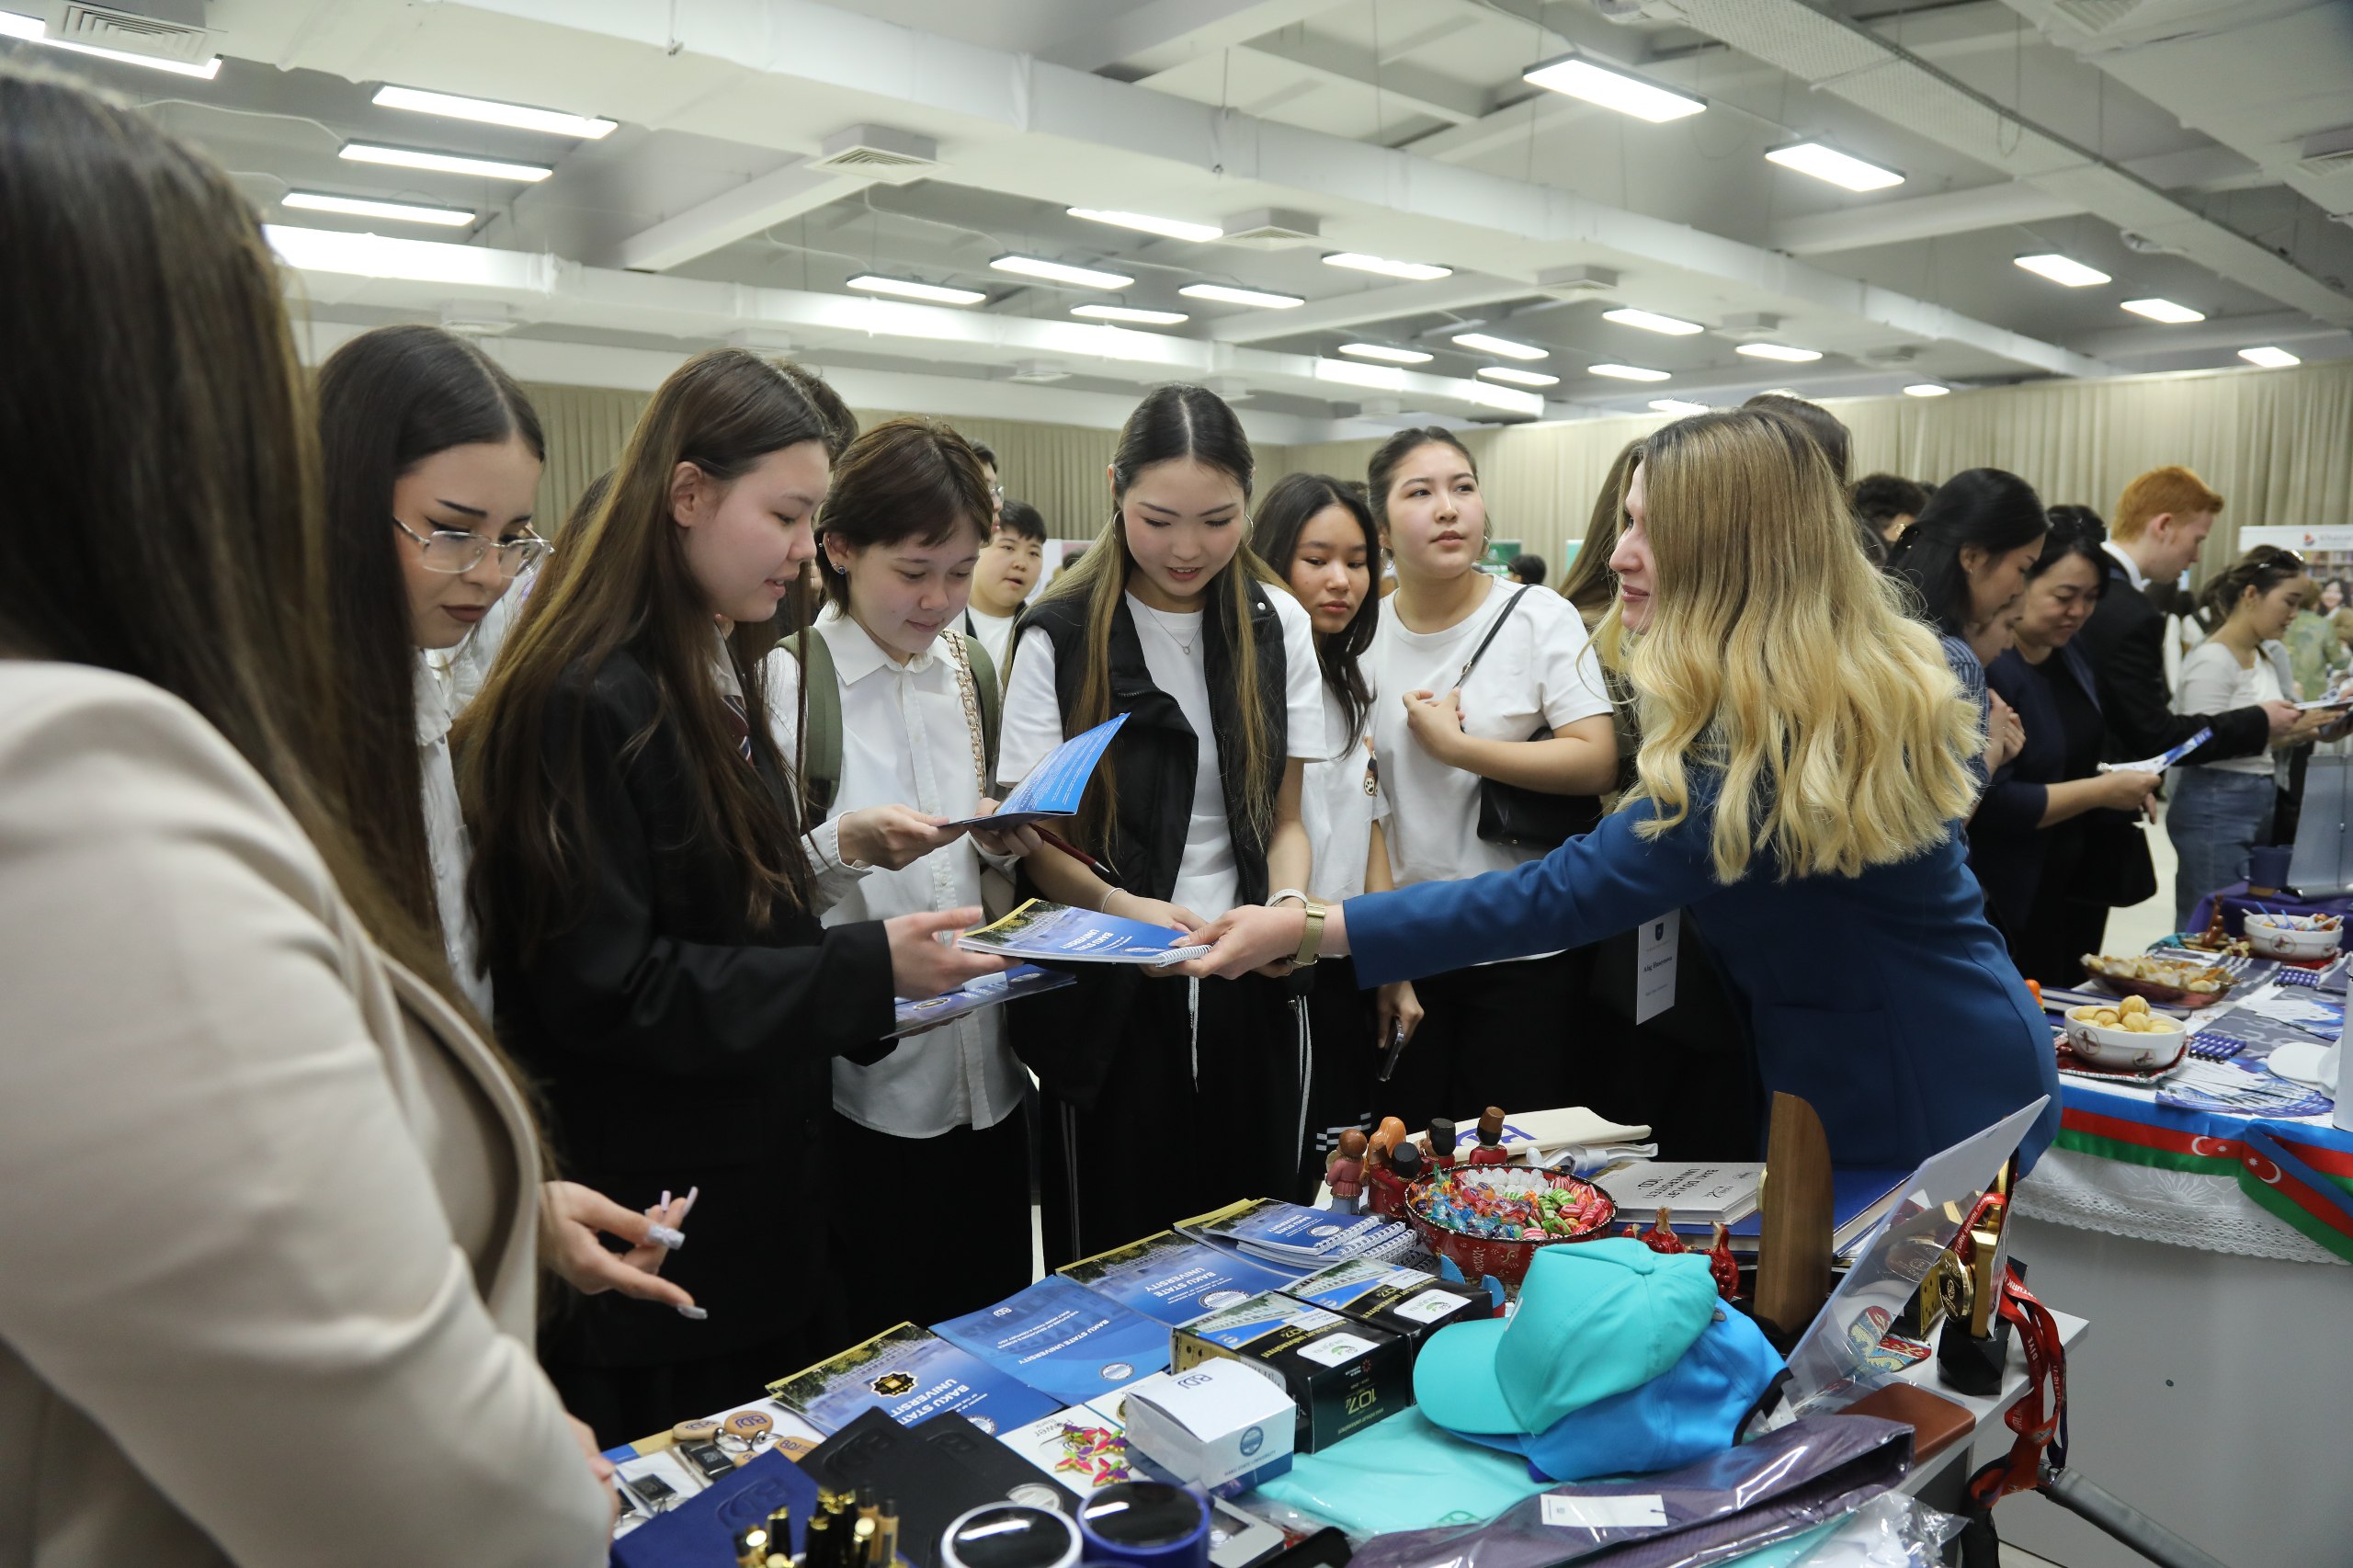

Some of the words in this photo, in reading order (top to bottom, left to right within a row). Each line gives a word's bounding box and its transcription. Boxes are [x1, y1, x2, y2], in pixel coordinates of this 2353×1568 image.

[1145, 1267, 1205, 1292] UNIVERSITY
[1187, 1272, 1216, 1285] BAKU
[1154, 1283, 1187, 1297] STATE
[1087, 1319, 1110, 1335] BAKU
[1063, 1331, 1088, 1346] STATE
[1018, 1344, 1065, 1365] UNIVERSITY
[891, 1379, 957, 1417] UNIVERSIT
[933, 1385, 970, 1406] BAKU
